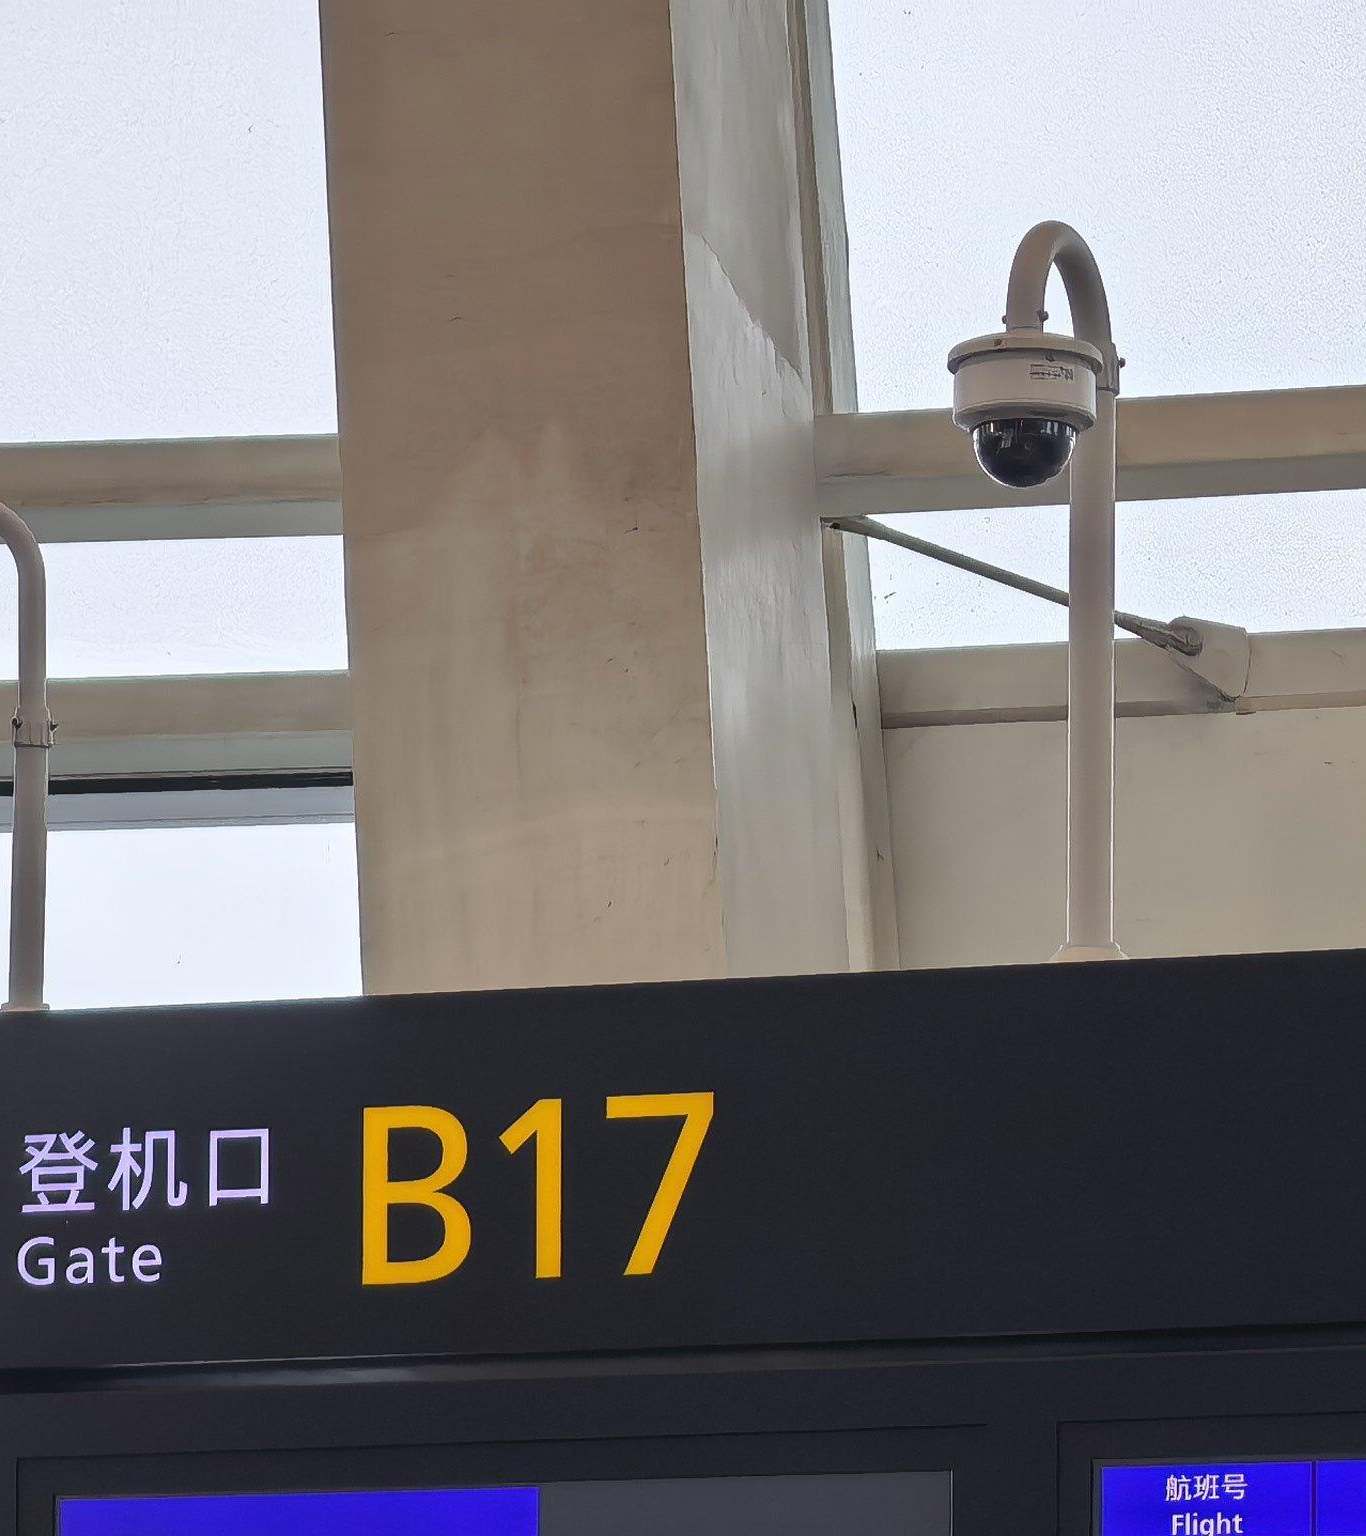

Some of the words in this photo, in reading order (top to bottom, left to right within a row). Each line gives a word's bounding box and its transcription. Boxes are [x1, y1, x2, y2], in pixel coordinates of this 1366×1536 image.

[18, 1127, 271, 1213] 登机口
[362, 1091, 713, 1285] B17
[17, 1239, 163, 1286] Gate
[1165, 1473, 1248, 1503] 航班号
